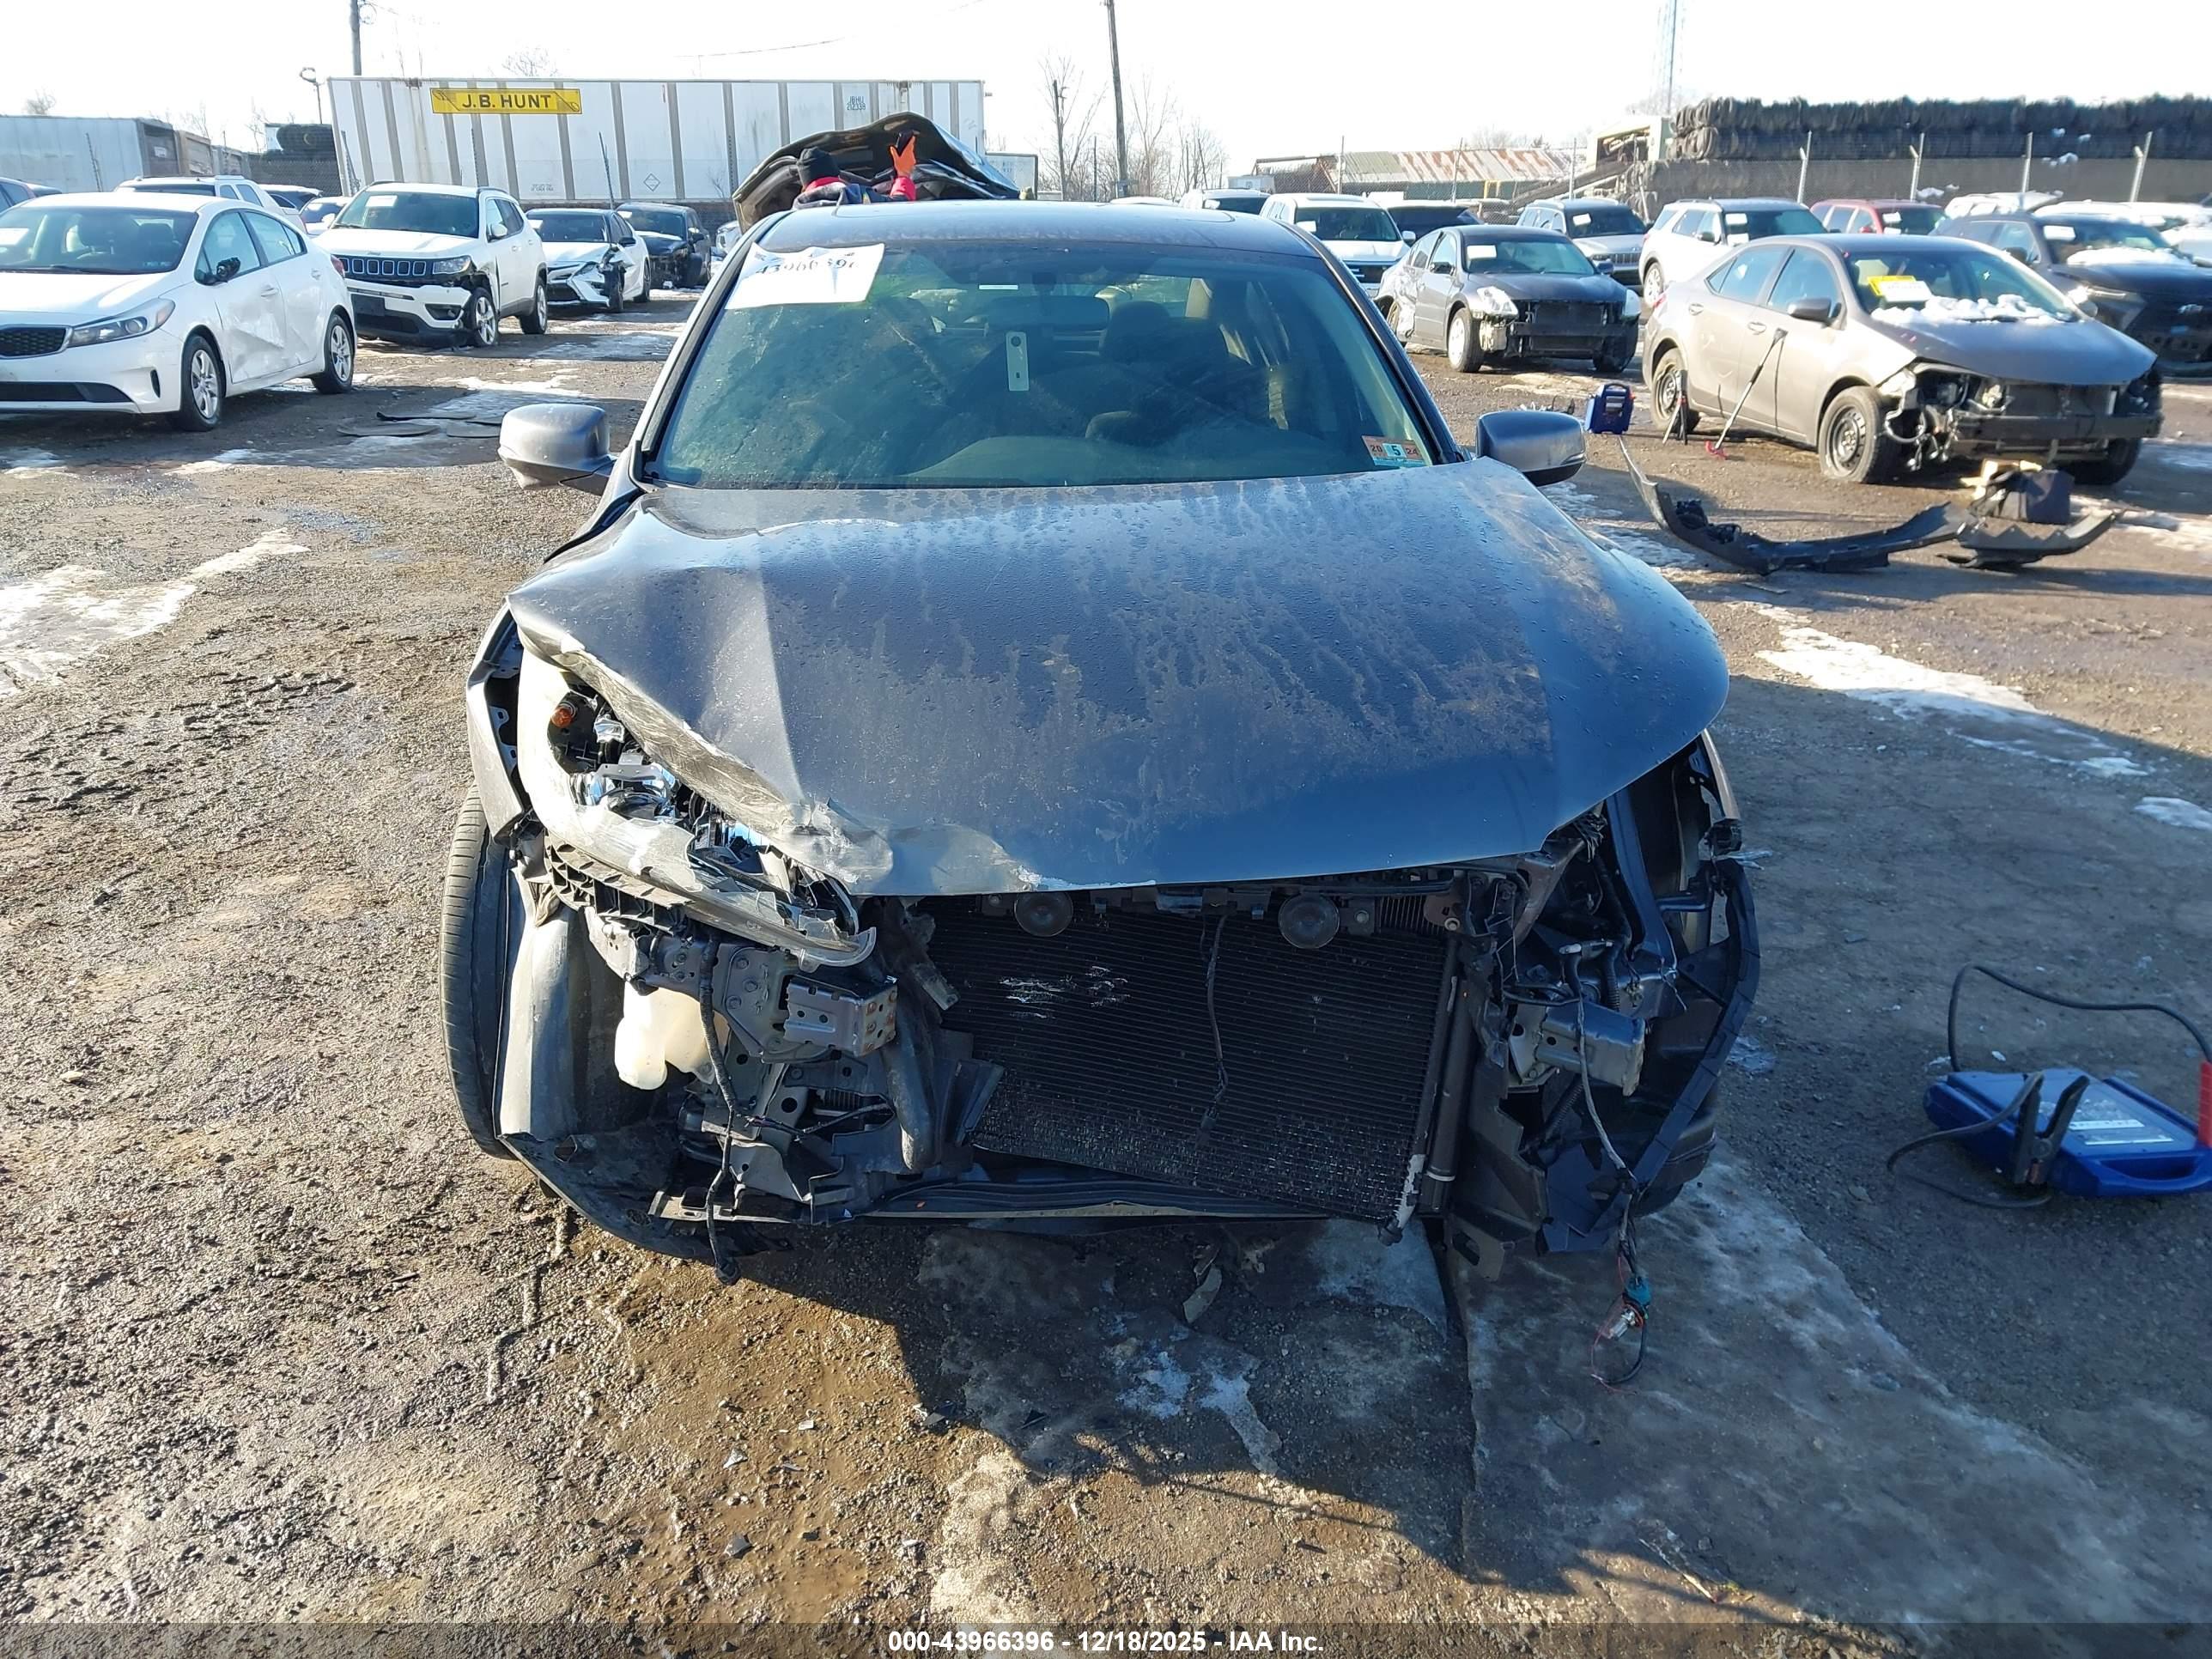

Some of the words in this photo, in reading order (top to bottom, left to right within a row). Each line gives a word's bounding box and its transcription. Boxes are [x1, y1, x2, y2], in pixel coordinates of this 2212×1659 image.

[462, 94, 495, 108] J.B.
[501, 94, 551, 108] HUNT
[1391, 445, 1401, 456] 5
